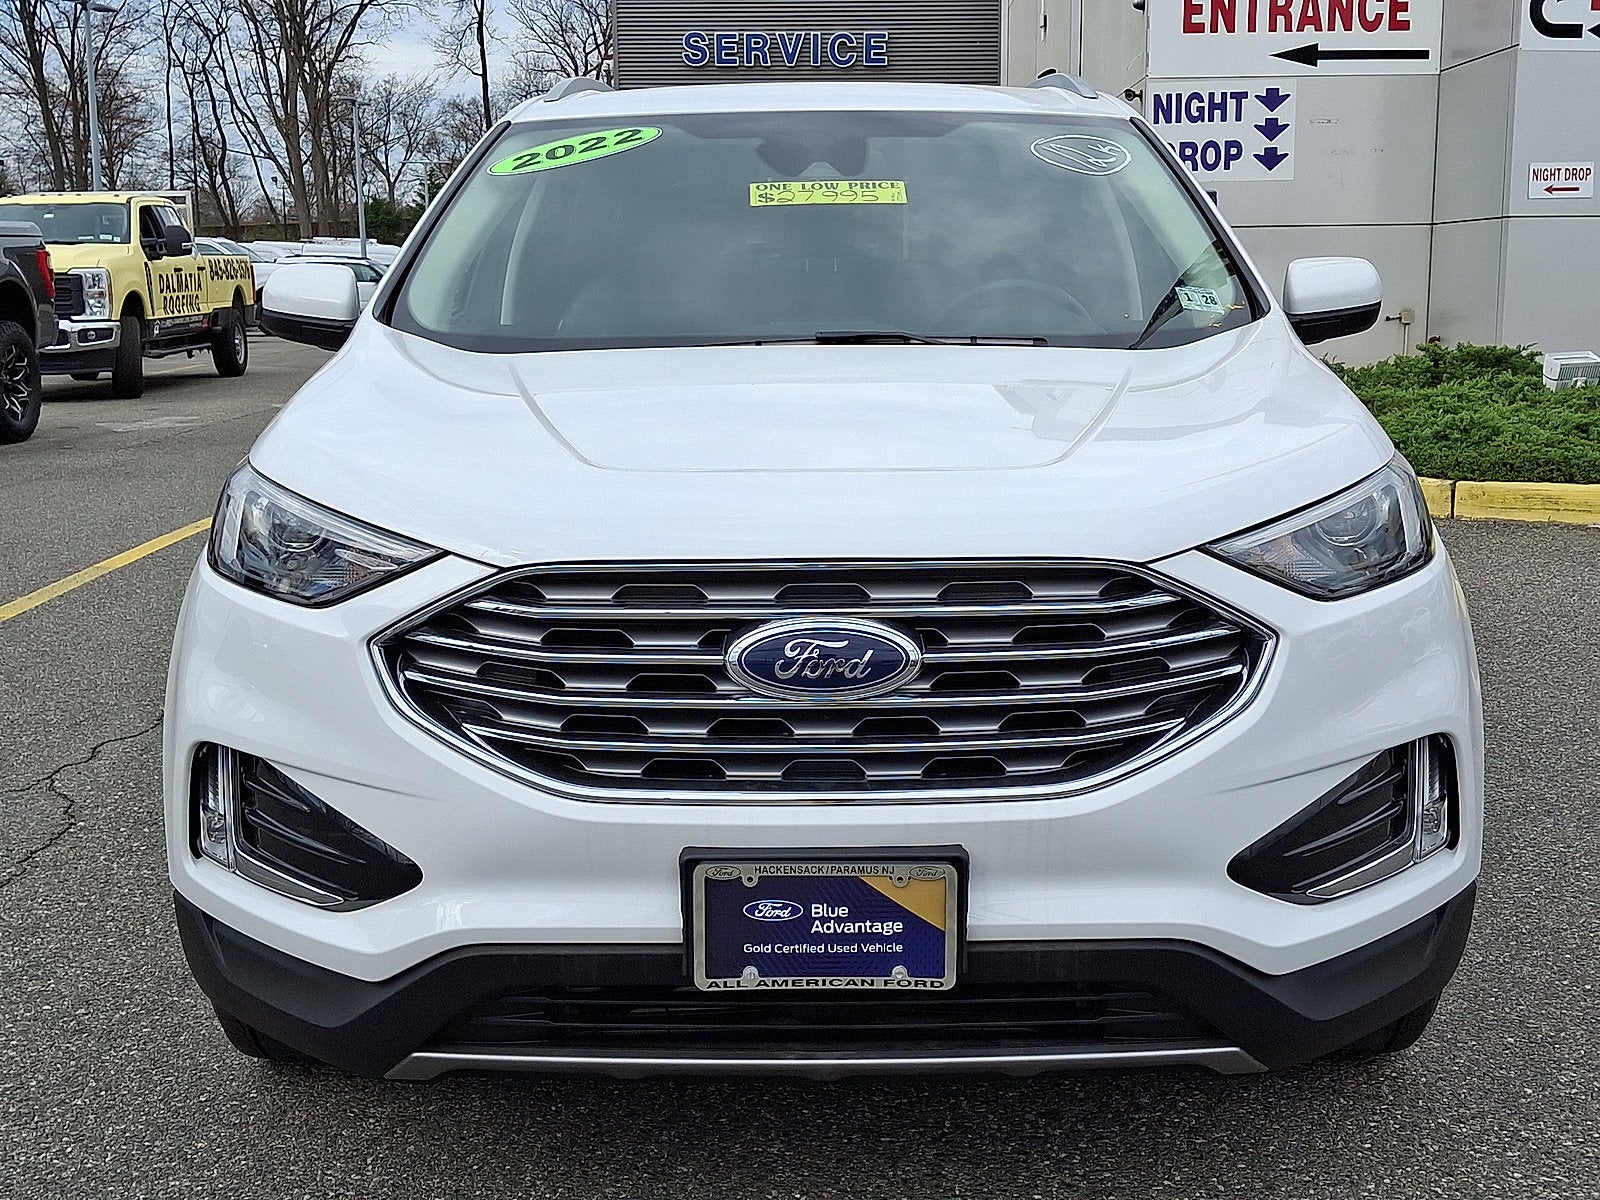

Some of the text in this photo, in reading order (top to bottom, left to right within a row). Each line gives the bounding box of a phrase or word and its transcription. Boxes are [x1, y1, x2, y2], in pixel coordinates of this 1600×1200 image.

[682, 31, 888, 67] SERVICE
[1153, 91, 1249, 125] NIGHT
[512, 129, 643, 171] 2022
[1532, 167, 1592, 181] NIGHT DROP
[755, 181, 901, 191] ONE LOW PRICE
[159, 273, 203, 294] DALMATIA
[162, 294, 201, 315] ROOFING
[1183, 292, 1193, 302] 1
[1202, 295, 1218, 306] 28
[774, 638, 875, 680] Ford
[881, 865, 895, 875] NJ
[754, 902, 793, 918] Ford
[811, 903, 849, 918] Blue
[810, 920, 903, 936] Advantage
[743, 943, 903, 954] Gold Certified Used Vehicle
[706, 979, 945, 989] ALL AMERICAN FORD
